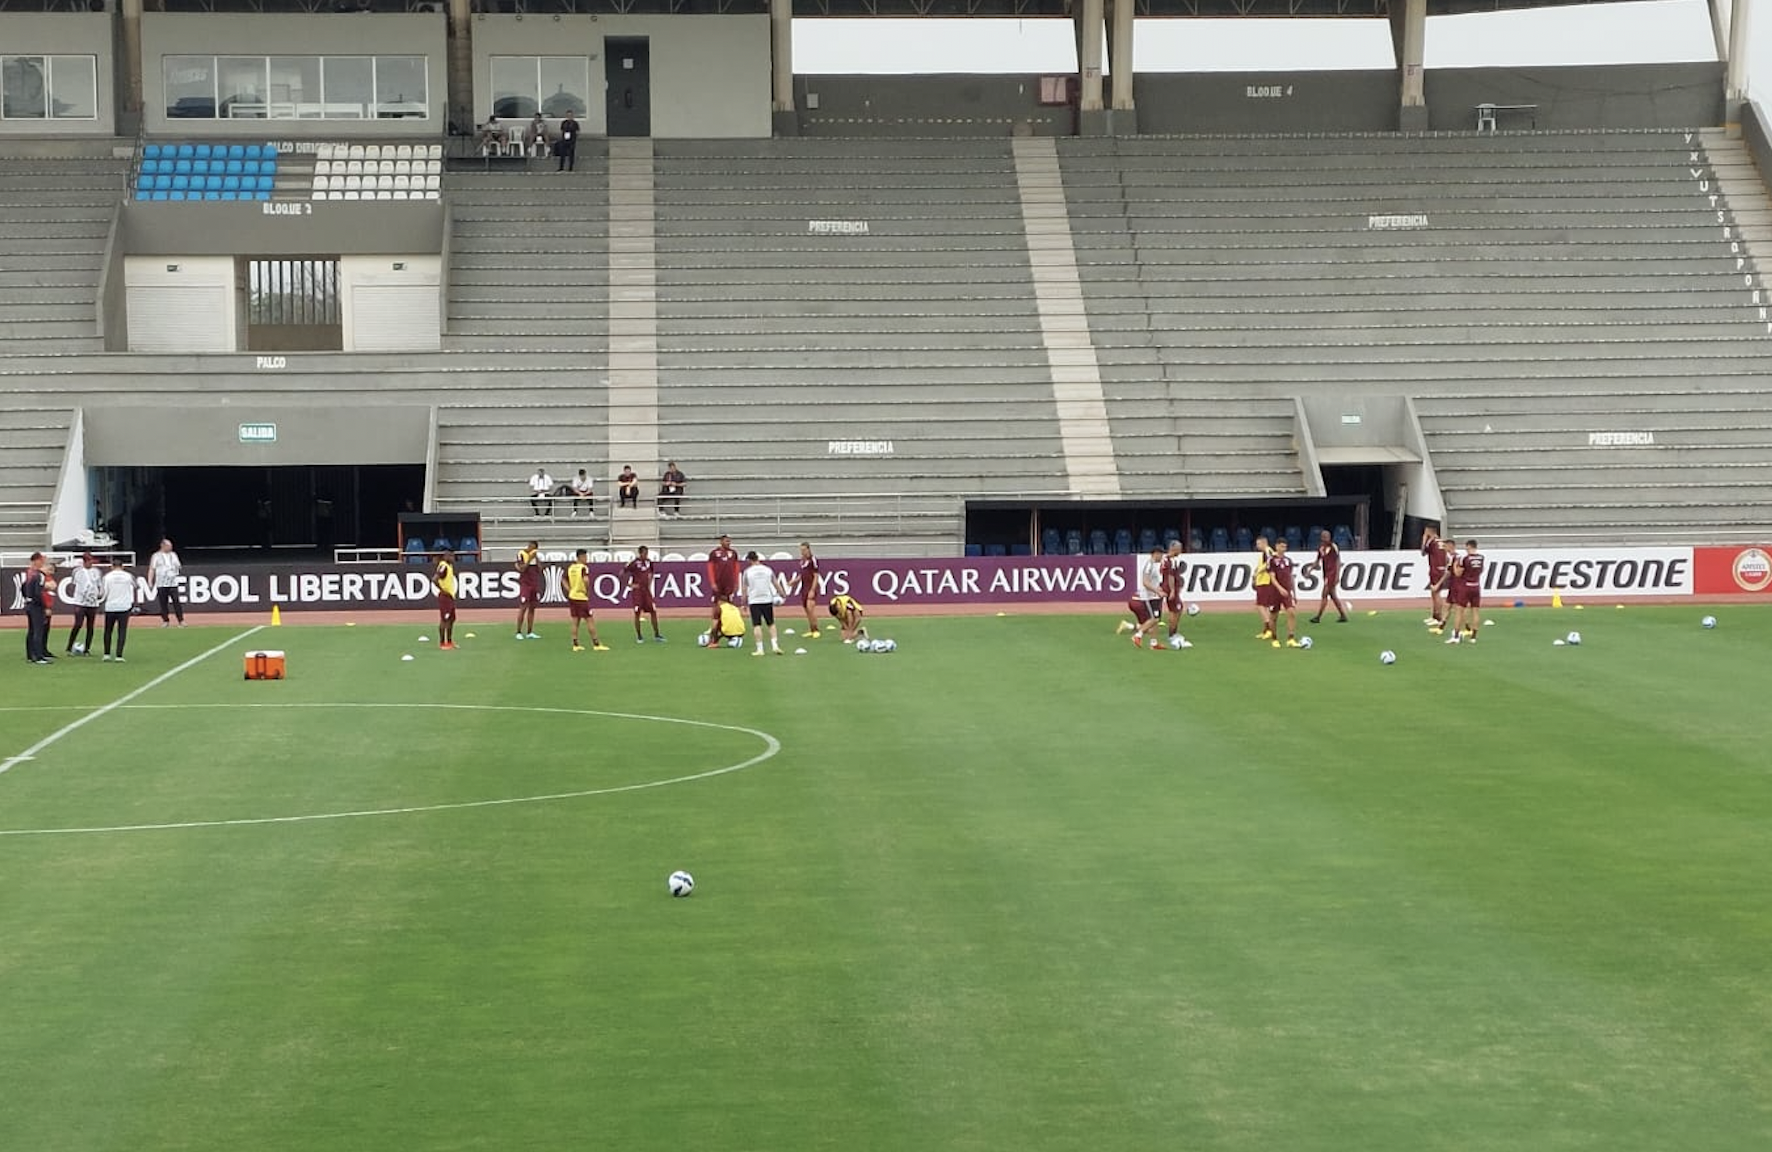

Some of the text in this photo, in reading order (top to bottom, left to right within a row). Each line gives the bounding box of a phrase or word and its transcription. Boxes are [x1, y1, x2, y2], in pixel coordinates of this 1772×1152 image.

[1247, 86, 1282, 97] BLOQUE
[1690, 152, 1699, 161] X
[1690, 168, 1703, 178] V
[1700, 181, 1708, 192] U
[1708, 195, 1718, 207] T
[263, 203, 301, 215] BLOQUE
[1369, 215, 1428, 229] PREFERENCIA
[1718, 210, 1724, 223] S
[809, 220, 869, 233] PREFERENCIA
[1737, 258, 1744, 270] P
[256, 356, 286, 369] PALCO
[241, 427, 274, 439] SALIDA
[1589, 432, 1654, 446] PREFERENCIA
[828, 441, 894, 454] PREFERENCIA
[1425, 558, 1688, 591] IDGESTONE
[58, 574, 260, 605] CMEBOL
[594, 572, 704, 604] QTAR
[872, 566, 1126, 600] QATAR AIRWAYS
